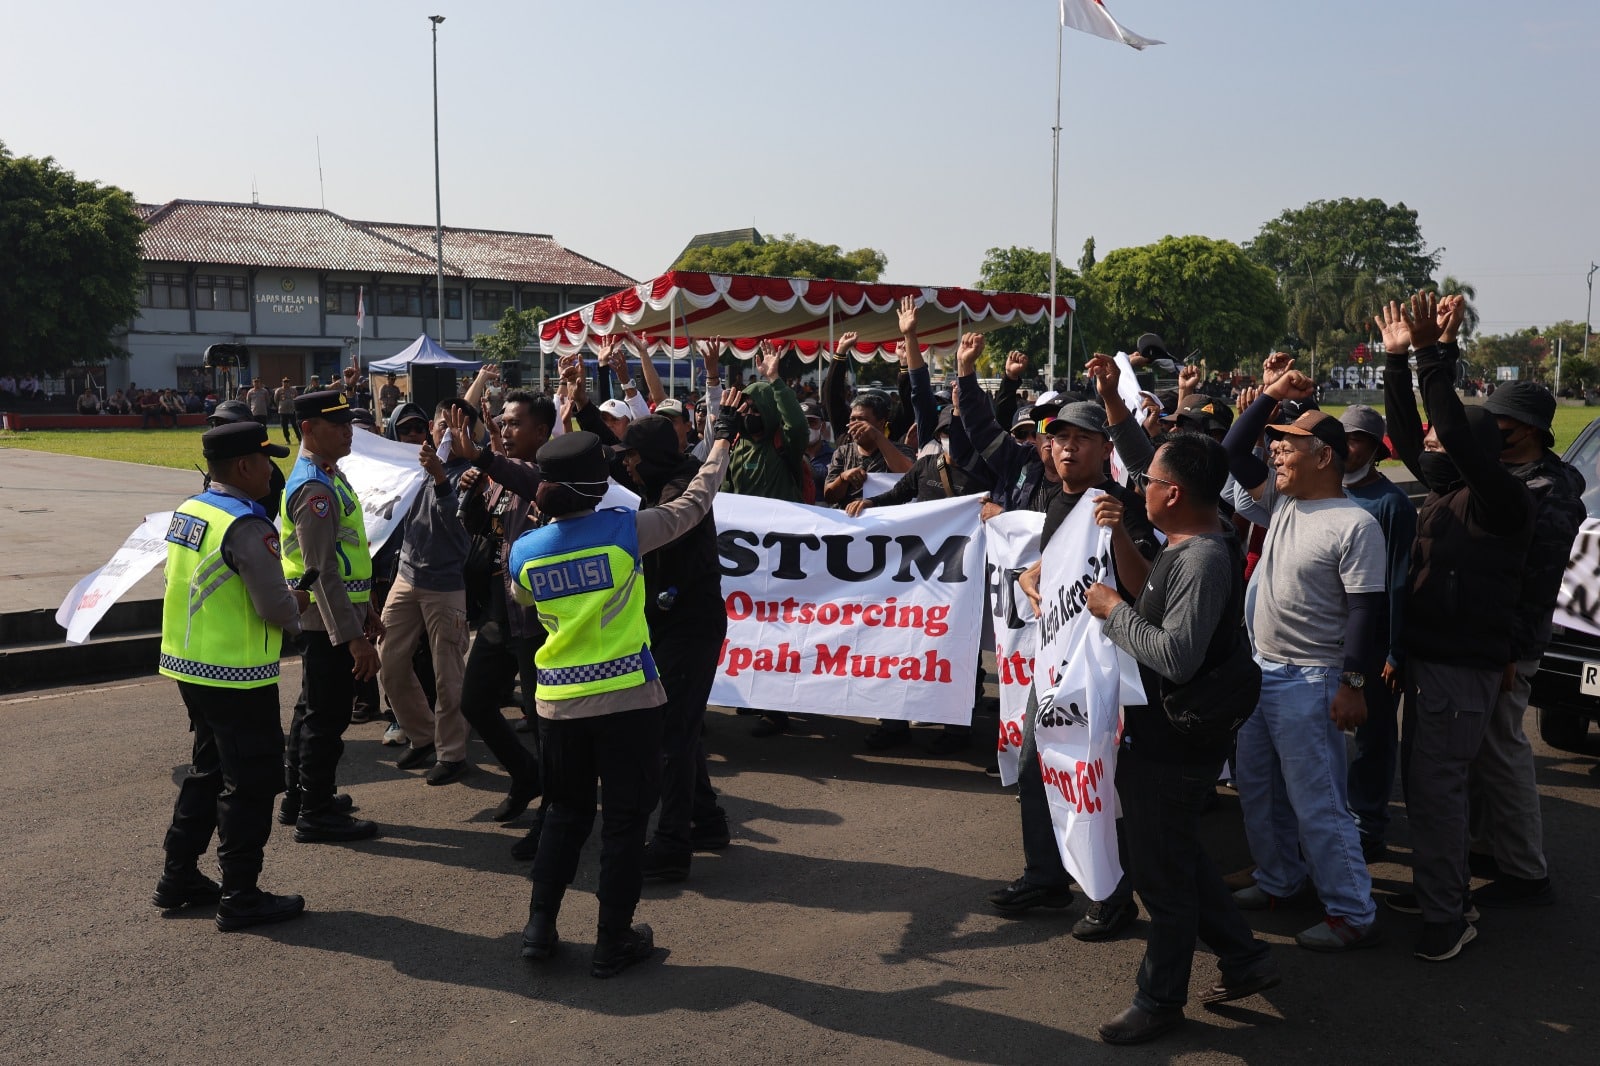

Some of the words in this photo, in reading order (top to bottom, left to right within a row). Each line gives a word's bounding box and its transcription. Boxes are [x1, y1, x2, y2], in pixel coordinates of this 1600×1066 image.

[256, 294, 280, 303] LAPAS
[281, 295, 305, 304] KELAS
[168, 517, 205, 546] POLISI
[531, 559, 608, 596] POLISI
[725, 591, 950, 637] Outsorcing
[812, 644, 952, 683] Murah
